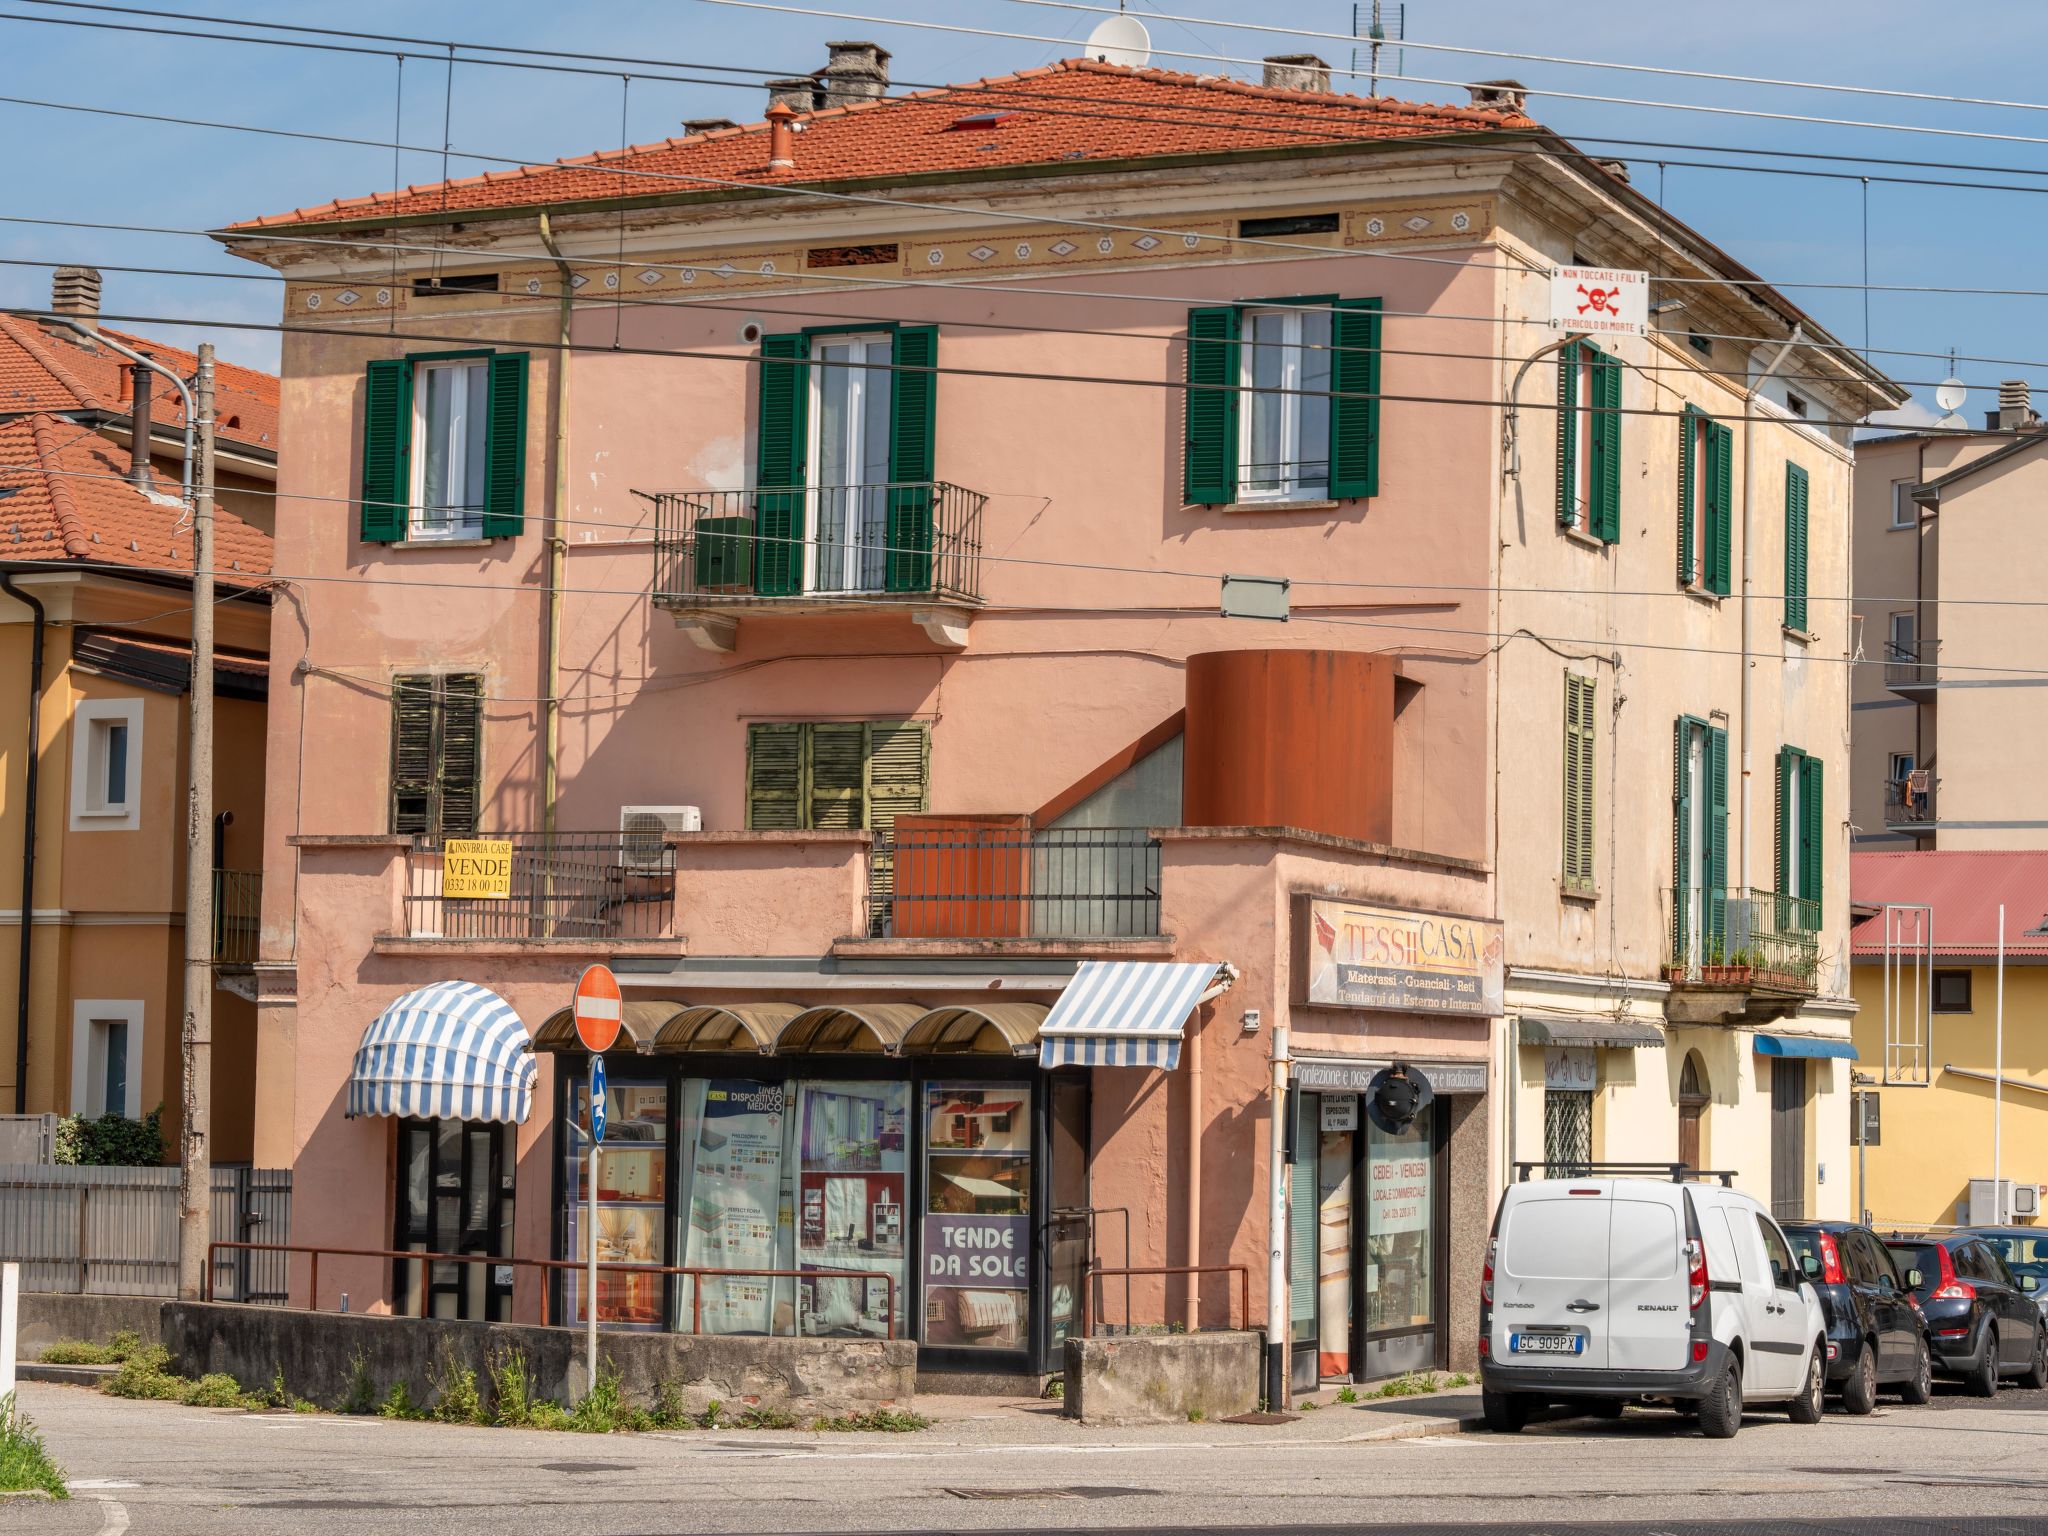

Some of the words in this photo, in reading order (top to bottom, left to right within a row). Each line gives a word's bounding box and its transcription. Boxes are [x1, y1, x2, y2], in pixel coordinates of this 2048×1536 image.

[1563, 269, 1577, 279] NON
[1580, 270, 1614, 282] TOCCATE
[1621, 273, 1636, 284] FILI
[1562, 318, 1599, 330] PERICOLO
[1600, 321, 1608, 330] DI
[1610, 321, 1634, 333] MORTE
[455, 842, 488, 854] INSVBRIA
[490, 843, 510, 855] CASE
[448, 858, 509, 877] VENDE
[445, 878, 465, 891] 0332
[467, 878, 477, 891] 18
[479, 879, 490, 892] 00
[493, 880, 508, 893] 121
[1347, 970, 1397, 986] Materassi
[1405, 975, 1450, 991] Guanciali
[1457, 980, 1475, 993] Reti
[1338, 989, 1386, 1006] Tendaggi
[1389, 994, 1400, 1005] da
[1403, 994, 1440, 1008] Esterno
[1441, 1000, 1447, 1008] e
[1449, 997, 1482, 1011] Interno
[1294, 1064, 1341, 1086] Confezione
[1342, 1071, 1348, 1085] e
[1350, 1071, 1371, 1088] posa
[1439, 1074, 1445, 1086] e
[1446, 1069, 1485, 1088] tradizionali
[759, 1085, 783, 1095] LINEA
[731, 1092, 783, 1104] DISPOSITIVO
[747, 1101, 782, 1112] MEDICO
[1326, 1107, 1350, 1115] ESPOSIZIONE
[1400, 1162, 1426, 1178] VENDESI
[1373, 1188, 1392, 1201] LOCALE
[942, 1227, 1014, 1249] TENDE
[930, 1254, 960, 1276] DA
[969, 1255, 1026, 1277] SOLE
[1637, 1304, 1679, 1312] RENAULT
[1520, 1336, 1534, 1349] GC
[1539, 1336, 1575, 1350] 909PX
